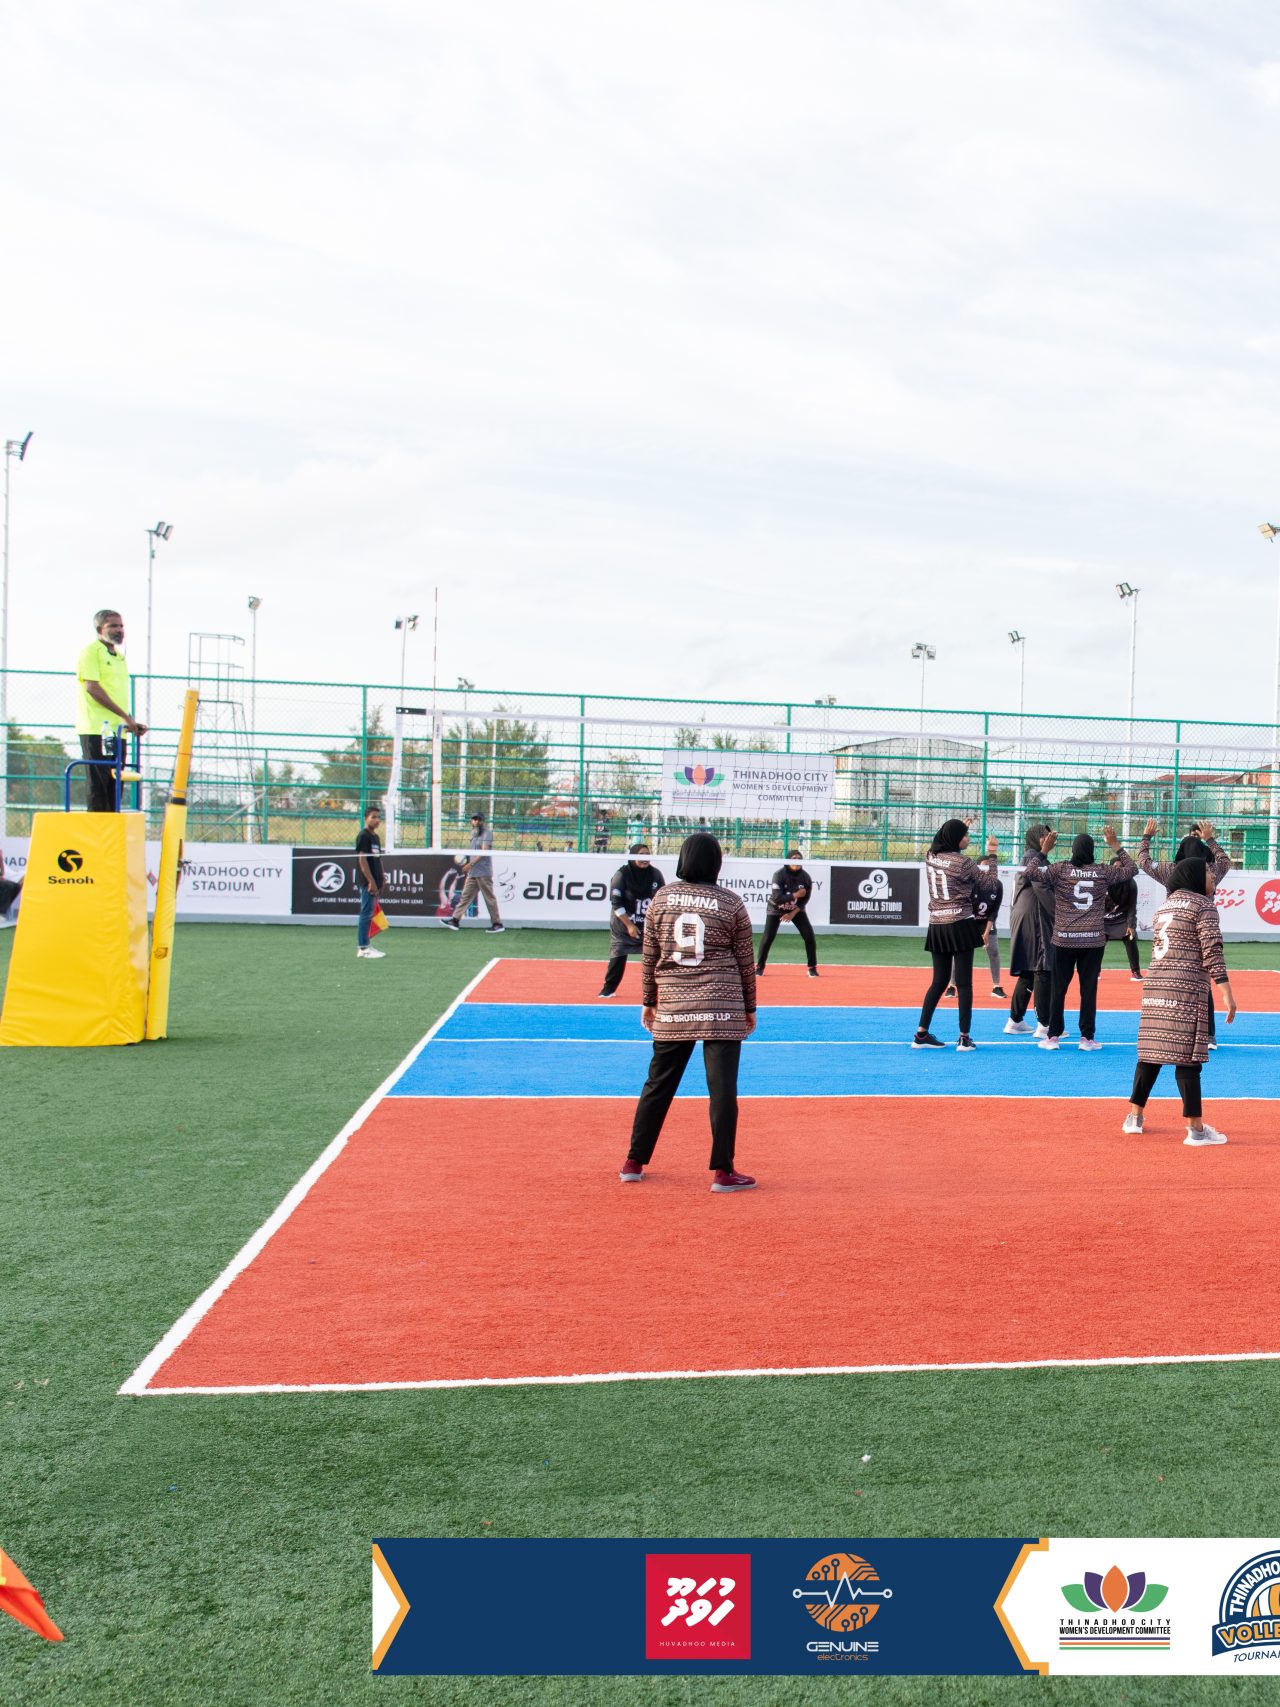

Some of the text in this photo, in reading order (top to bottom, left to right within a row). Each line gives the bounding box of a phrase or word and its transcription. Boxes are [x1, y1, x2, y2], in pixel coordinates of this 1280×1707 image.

[732, 770, 828, 782] THINADHOO CITY
[771, 785, 828, 793] DEVELOPMENT
[757, 794, 803, 802] COMMITTEE
[183, 866, 283, 878] INADHOO CITY
[1070, 869, 1098, 878] ATHIFA
[48, 875, 95, 885] Senoh
[192, 880, 255, 892] STADIUM
[718, 879, 772, 889] THINADH
[523, 875, 608, 901] alica
[1073, 881, 1094, 910] 5
[667, 893, 719, 911] SHIMNA
[848, 901, 902, 912] CHAPPALA STUDIO
[978, 902, 988, 916] 2
[673, 912, 706, 967] 9
[1153, 912, 1173, 960] 3
[674, 1012, 714, 1022] BROTHERS
